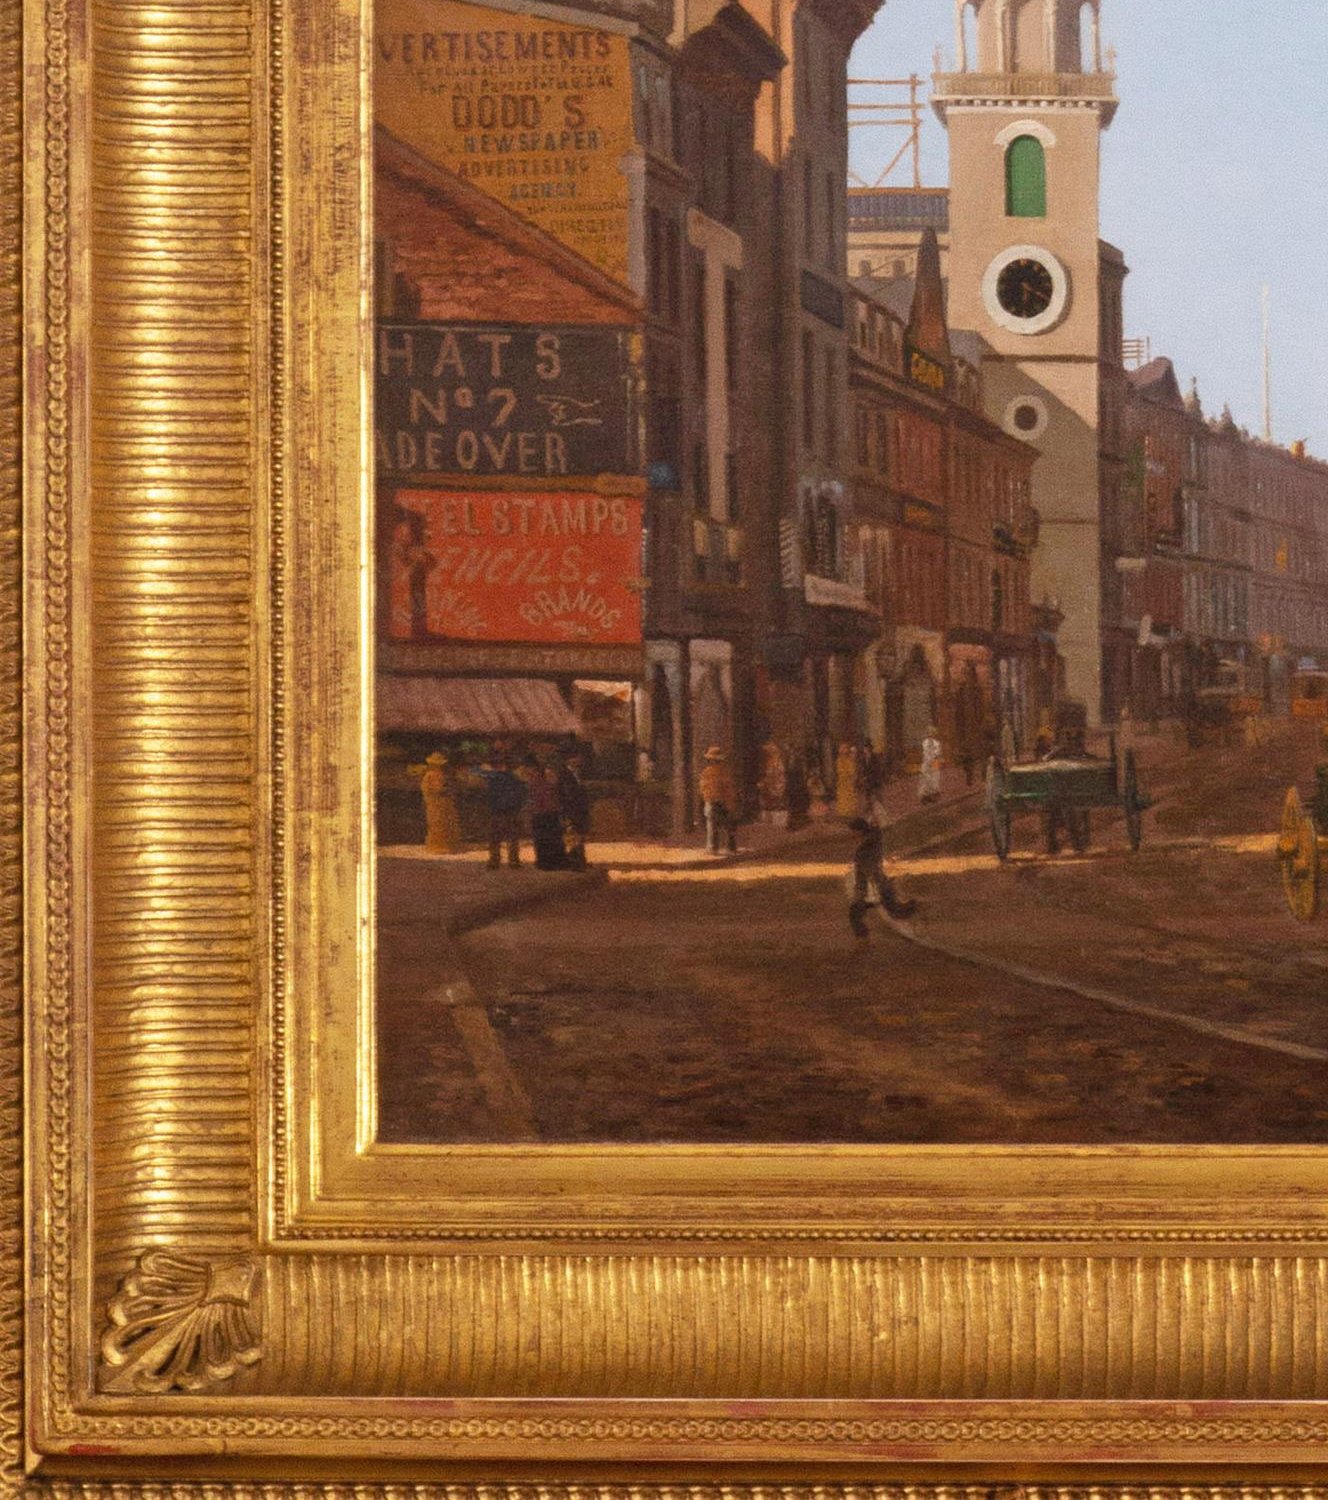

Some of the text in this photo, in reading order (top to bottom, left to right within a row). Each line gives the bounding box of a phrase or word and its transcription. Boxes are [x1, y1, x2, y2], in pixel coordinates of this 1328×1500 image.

[463, 130, 599, 154] NEWSPAPER
[457, 155, 591, 178] ADVERTISING
[379, 331, 562, 380] HATS
[492, 497, 629, 536] STAMPS
